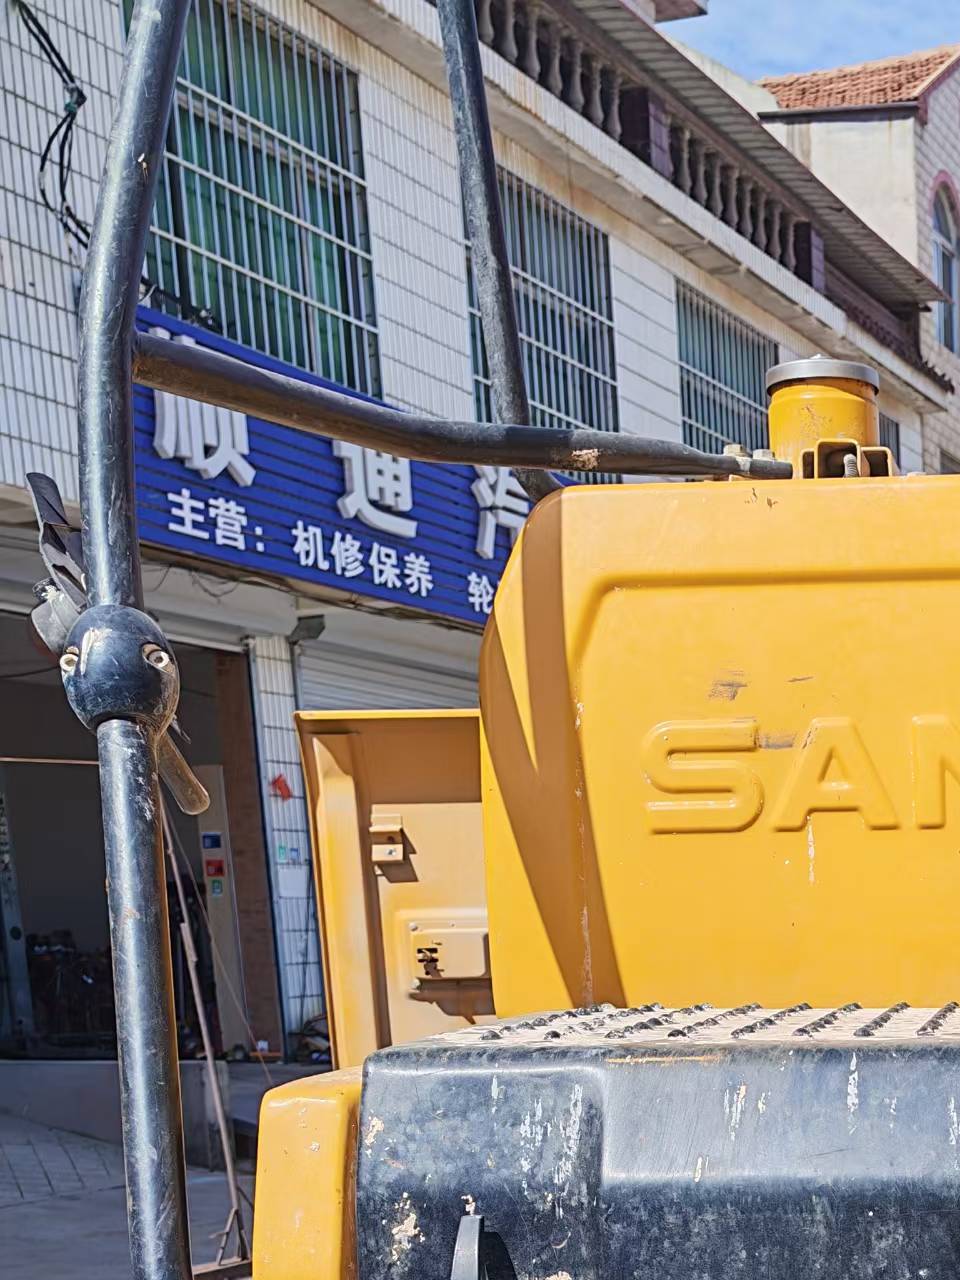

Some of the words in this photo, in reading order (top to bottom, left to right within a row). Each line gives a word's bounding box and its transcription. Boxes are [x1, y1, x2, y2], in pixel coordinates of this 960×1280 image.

[291, 520, 434, 597] 机修保养
[467, 571, 500, 614] 轮
